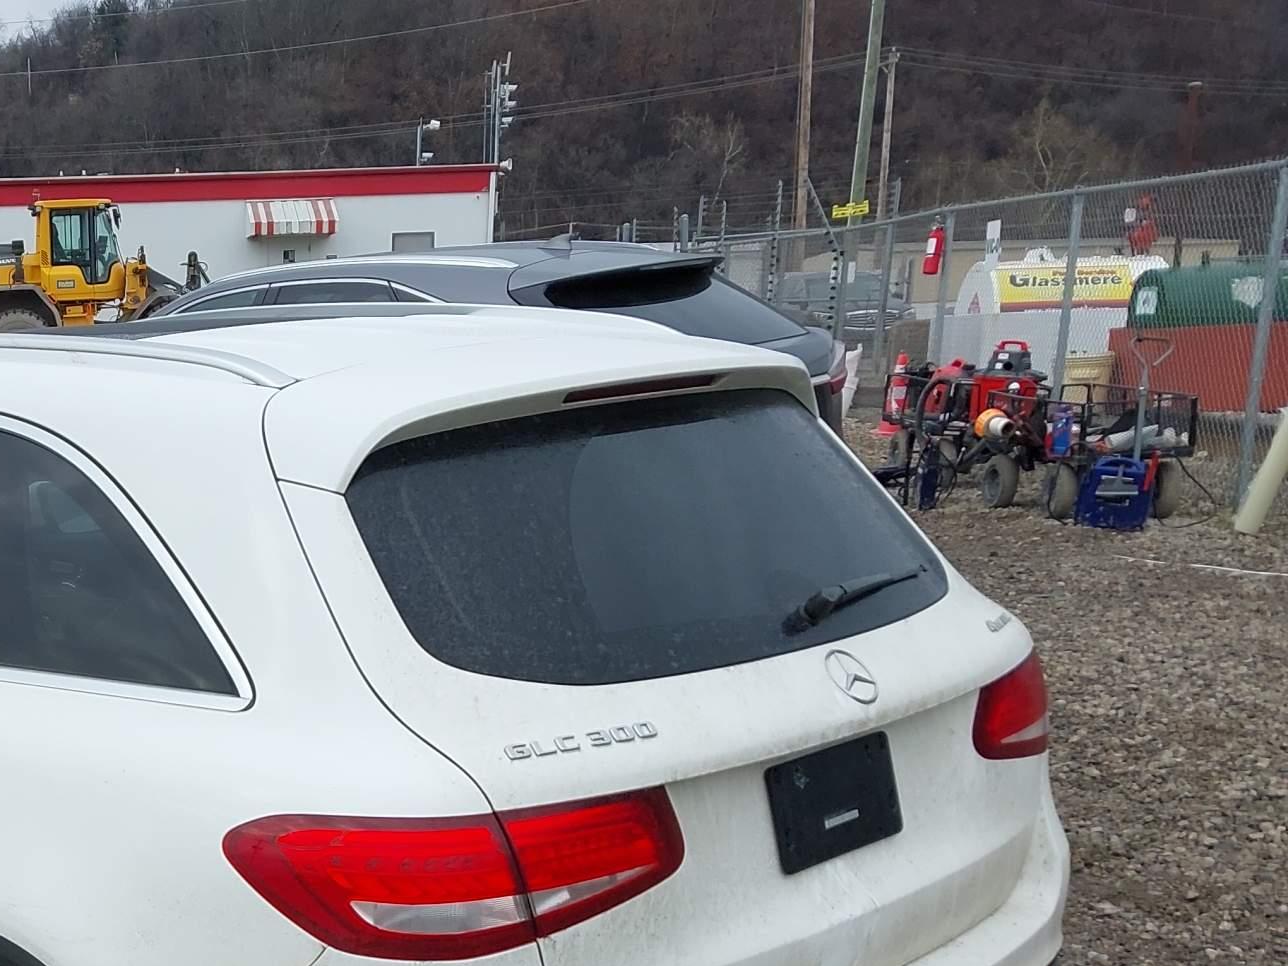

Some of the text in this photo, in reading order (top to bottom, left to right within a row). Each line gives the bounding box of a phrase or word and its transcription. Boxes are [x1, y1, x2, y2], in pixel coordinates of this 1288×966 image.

[1009, 273, 1122, 288] Glasmere
[503, 720, 658, 761] GLC 300
